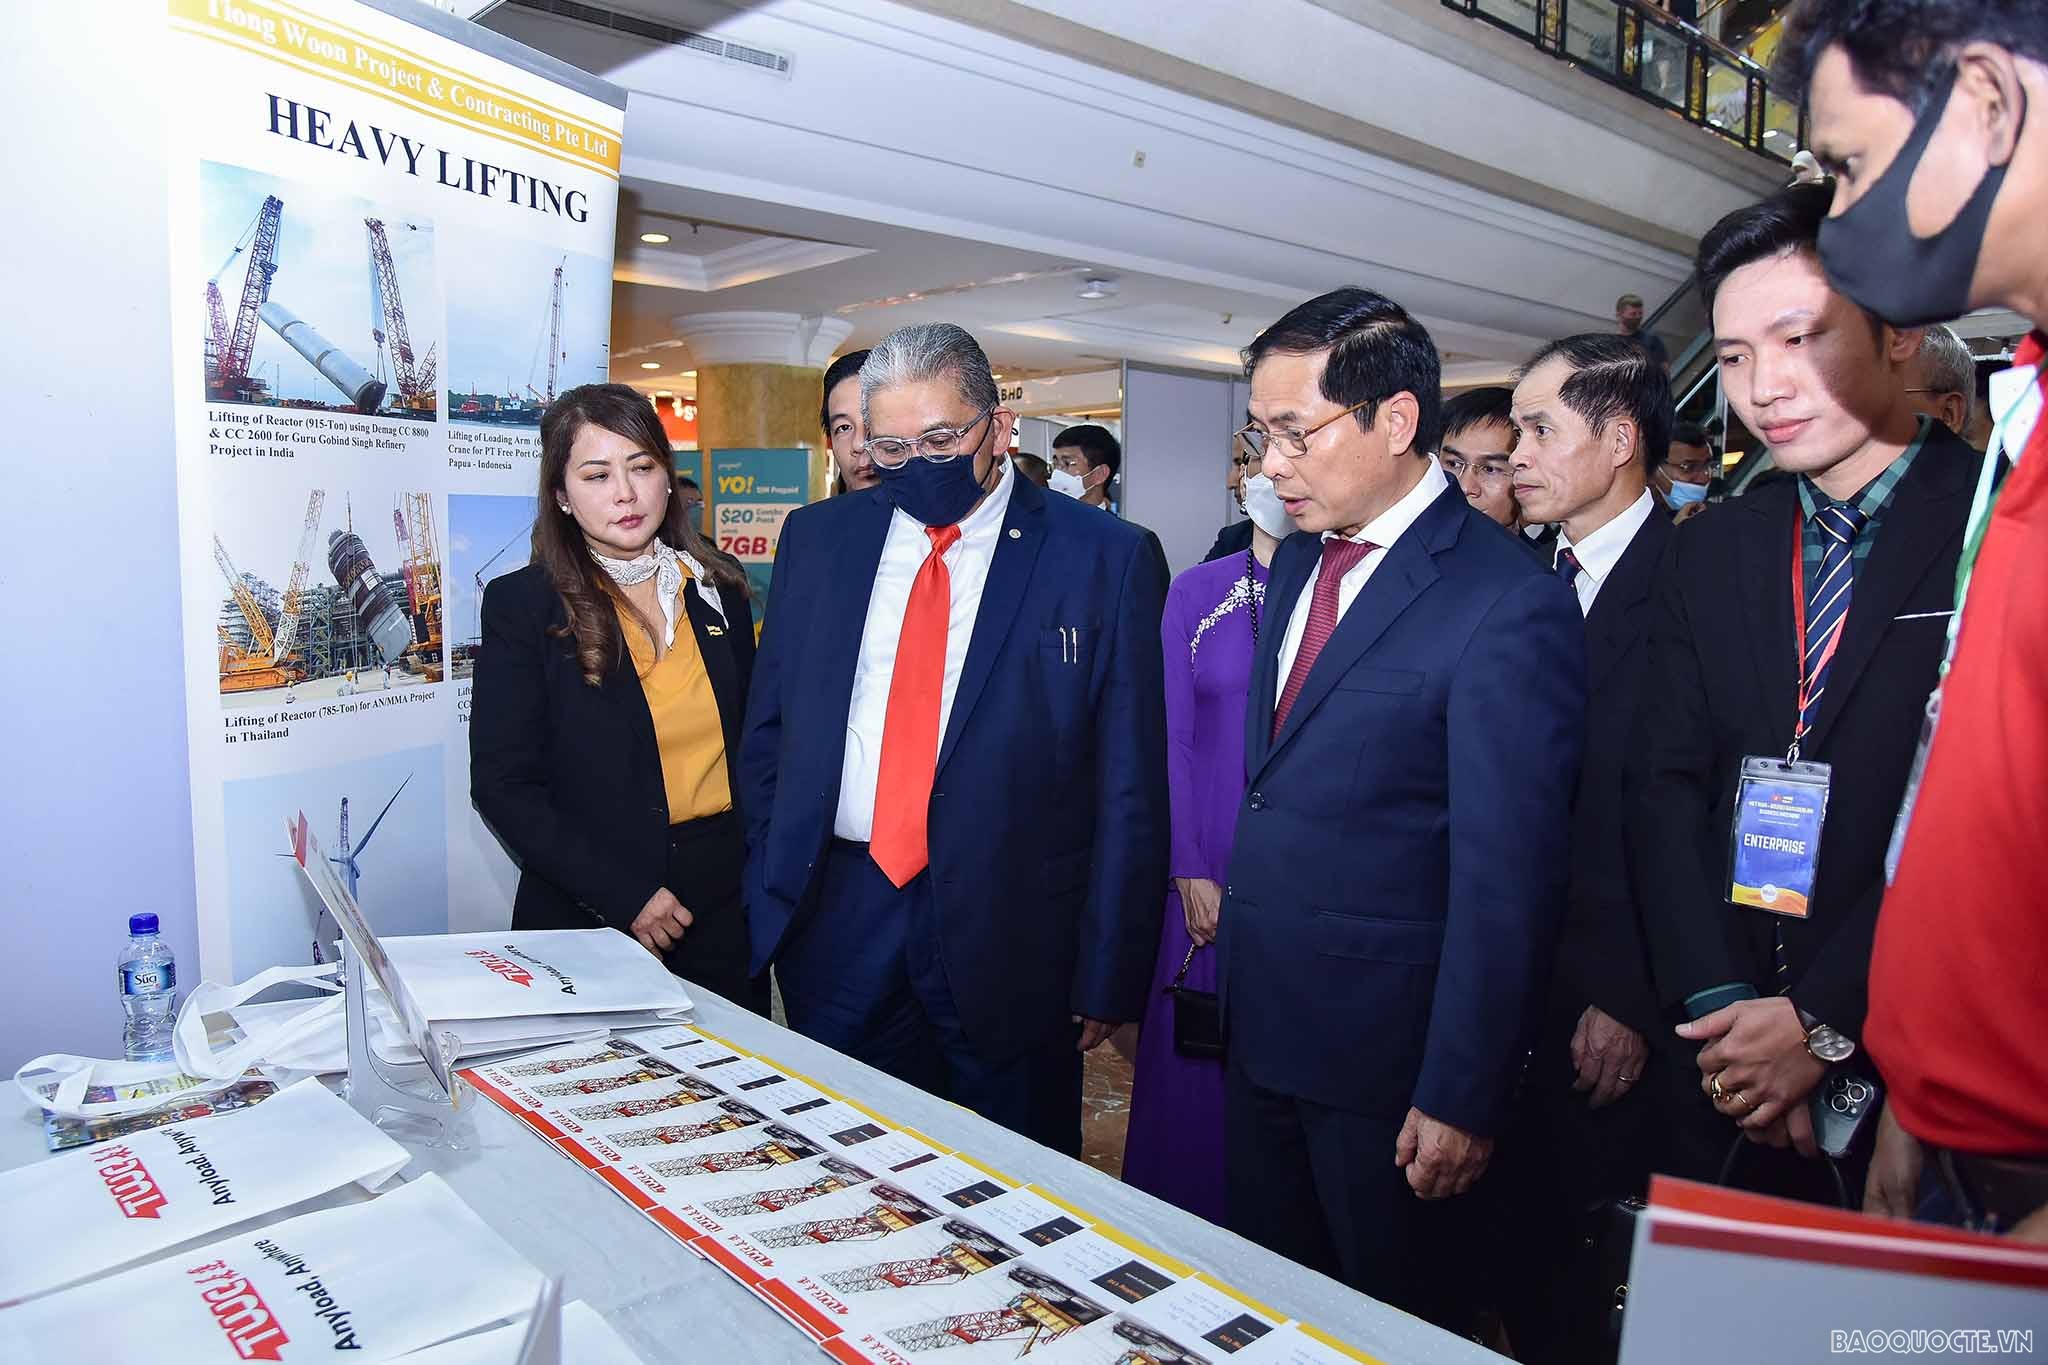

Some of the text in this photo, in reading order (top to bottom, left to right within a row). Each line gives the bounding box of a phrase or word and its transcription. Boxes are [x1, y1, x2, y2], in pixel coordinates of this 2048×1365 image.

[282, 18, 348, 65] Woon
[353, 46, 422, 89] Project
[427, 77, 445, 101] &
[450, 85, 552, 143] Contracting
[555, 122, 580, 147] Pte
[584, 131, 608, 158] Ltd
[264, 92, 590, 224] HEAVY LIFTING
[209, 411, 429, 438] Lifting of Reactor (915-Ton) using Demag CC 8800
[209, 427, 406, 452] & CC 2600 for Guru Gobind Singh Refinery
[448, 430, 472, 442] Lifting
[474, 433, 482, 441] of
[484, 433, 512, 445] Loading
[514, 436, 531, 445] Arm
[210, 444, 294, 458] Project in India
[448, 444, 470, 454] Crane
[472, 446, 483, 455] for
[485, 447, 495, 455] PT
[497, 448, 514, 457] Free
[515, 449, 531, 457] Port
[448, 458, 471, 469] Papua
[478, 460, 512, 470] Indonesia
[718, 475, 754, 494] YO!
[721, 508, 753, 525] $20
[720, 535, 767, 556] 7GB
[225, 716, 265, 728] Lifting
[267, 713, 278, 724] of
[281, 710, 317, 722] Reactor
[318, 702, 358, 719] (785-Ton)
[359, 701, 371, 710] for
[410, 691, 435, 702] Project
[225, 727, 289, 743] in Thailand
[1743, 833, 1806, 855] ENTERPRISE
